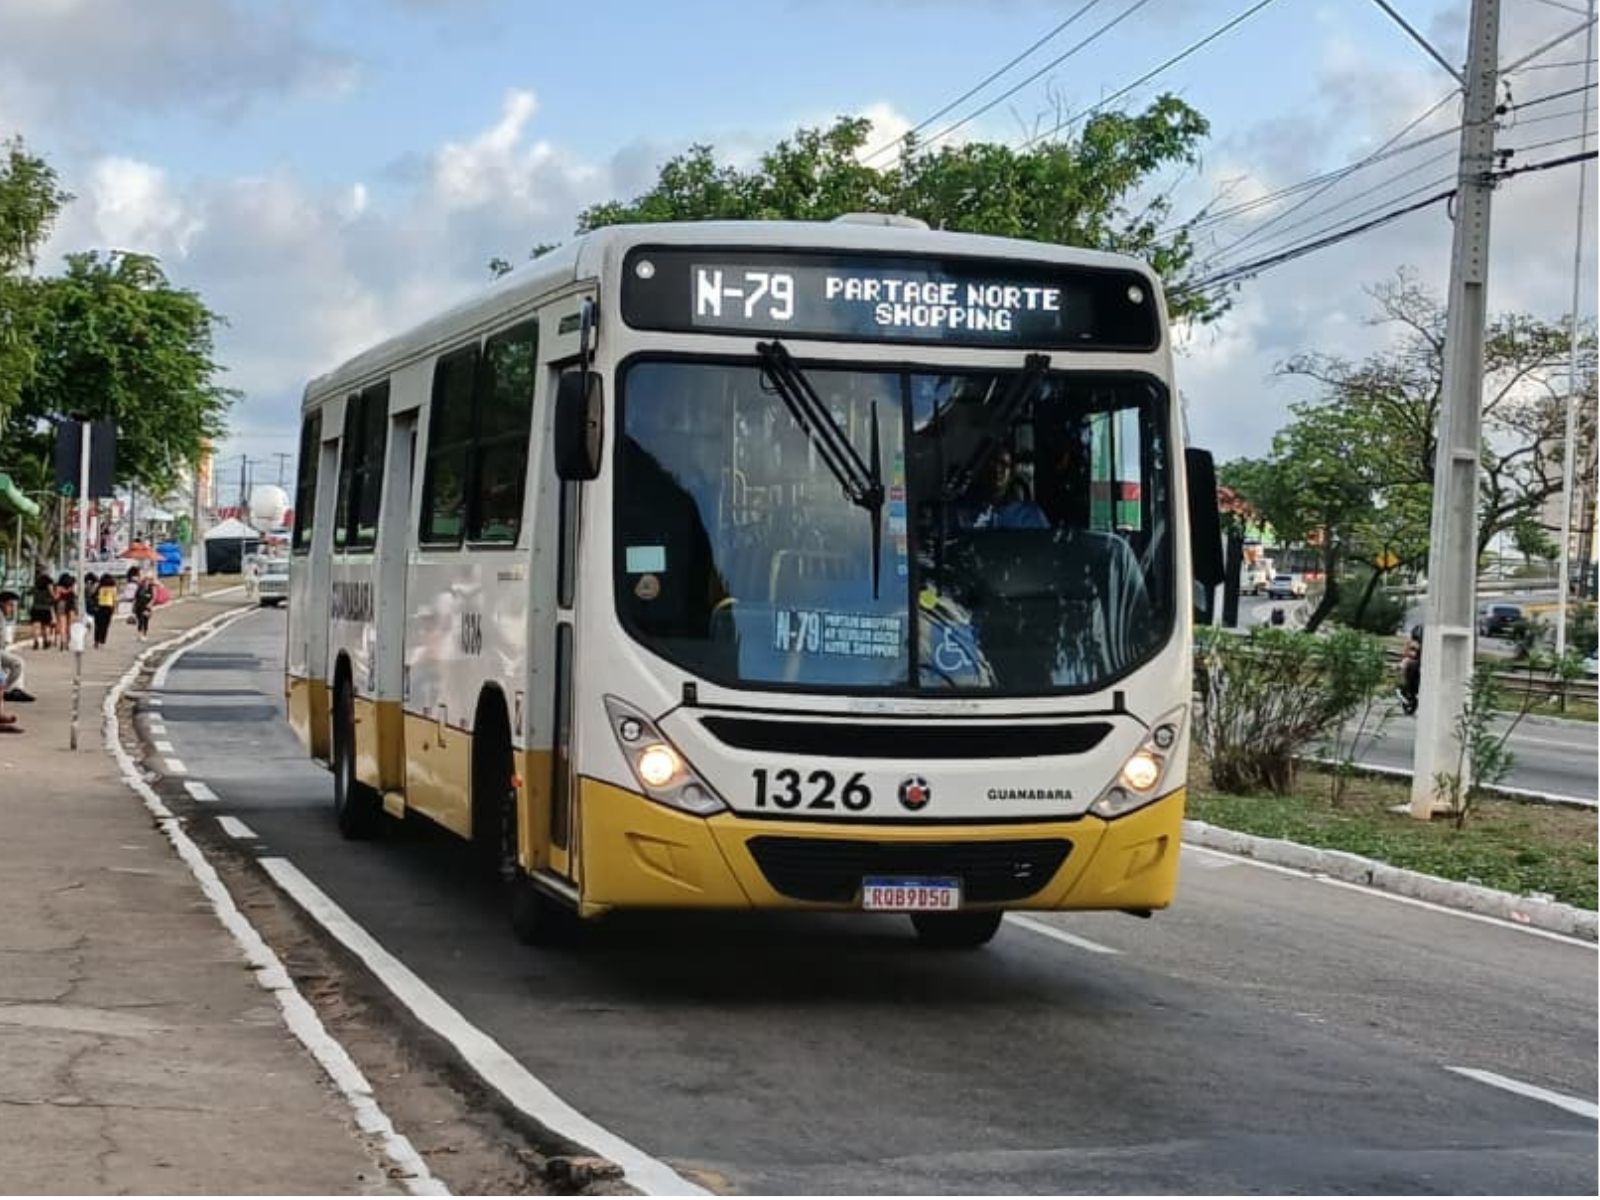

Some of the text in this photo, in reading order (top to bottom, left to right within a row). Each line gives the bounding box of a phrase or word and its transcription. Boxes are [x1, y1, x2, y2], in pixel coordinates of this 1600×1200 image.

[697, 269, 1061, 320] N-79 PARTAGE NORTE
[874, 303, 1012, 331] SHOPPING
[776, 610, 820, 652] N-79
[752, 769, 871, 811] 1326
[987, 788, 1073, 801] GUANABARA
